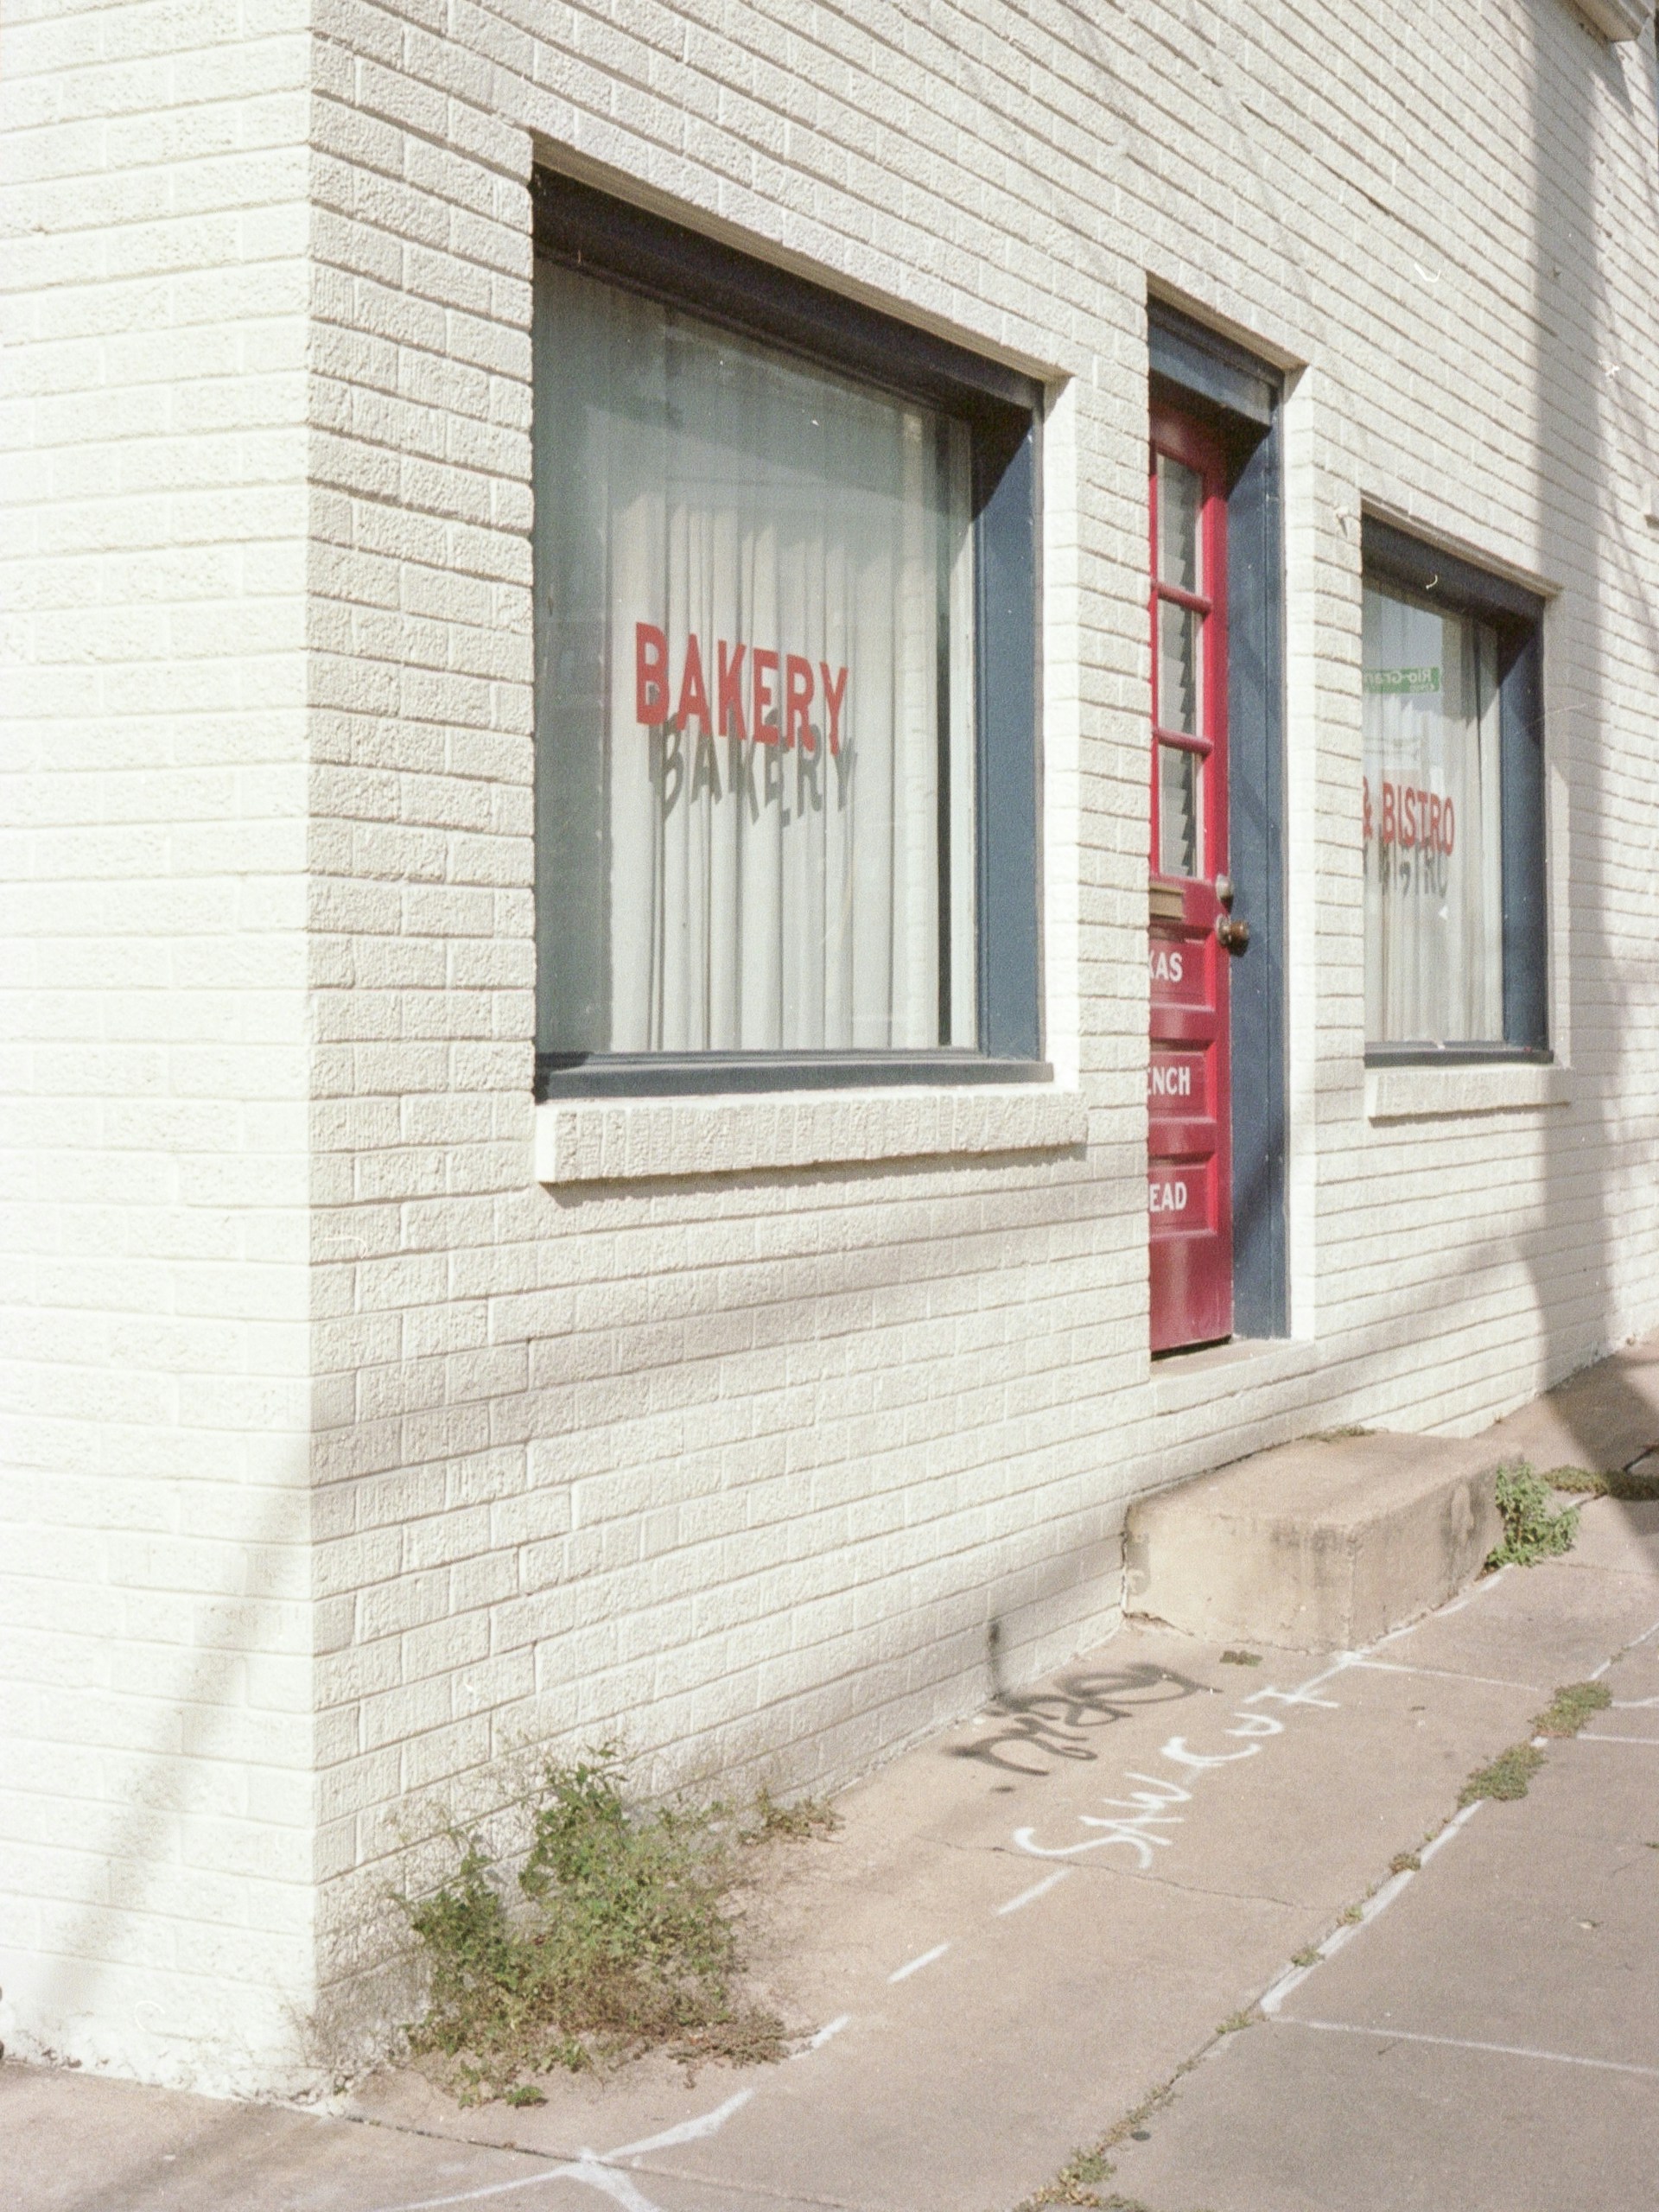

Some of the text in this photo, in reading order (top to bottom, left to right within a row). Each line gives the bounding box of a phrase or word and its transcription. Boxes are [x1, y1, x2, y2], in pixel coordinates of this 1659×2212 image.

[636, 621, 849, 757] BAKERY
[1382, 781, 1455, 856] BISTRO
[1147, 1065, 1191, 1096] NCH
